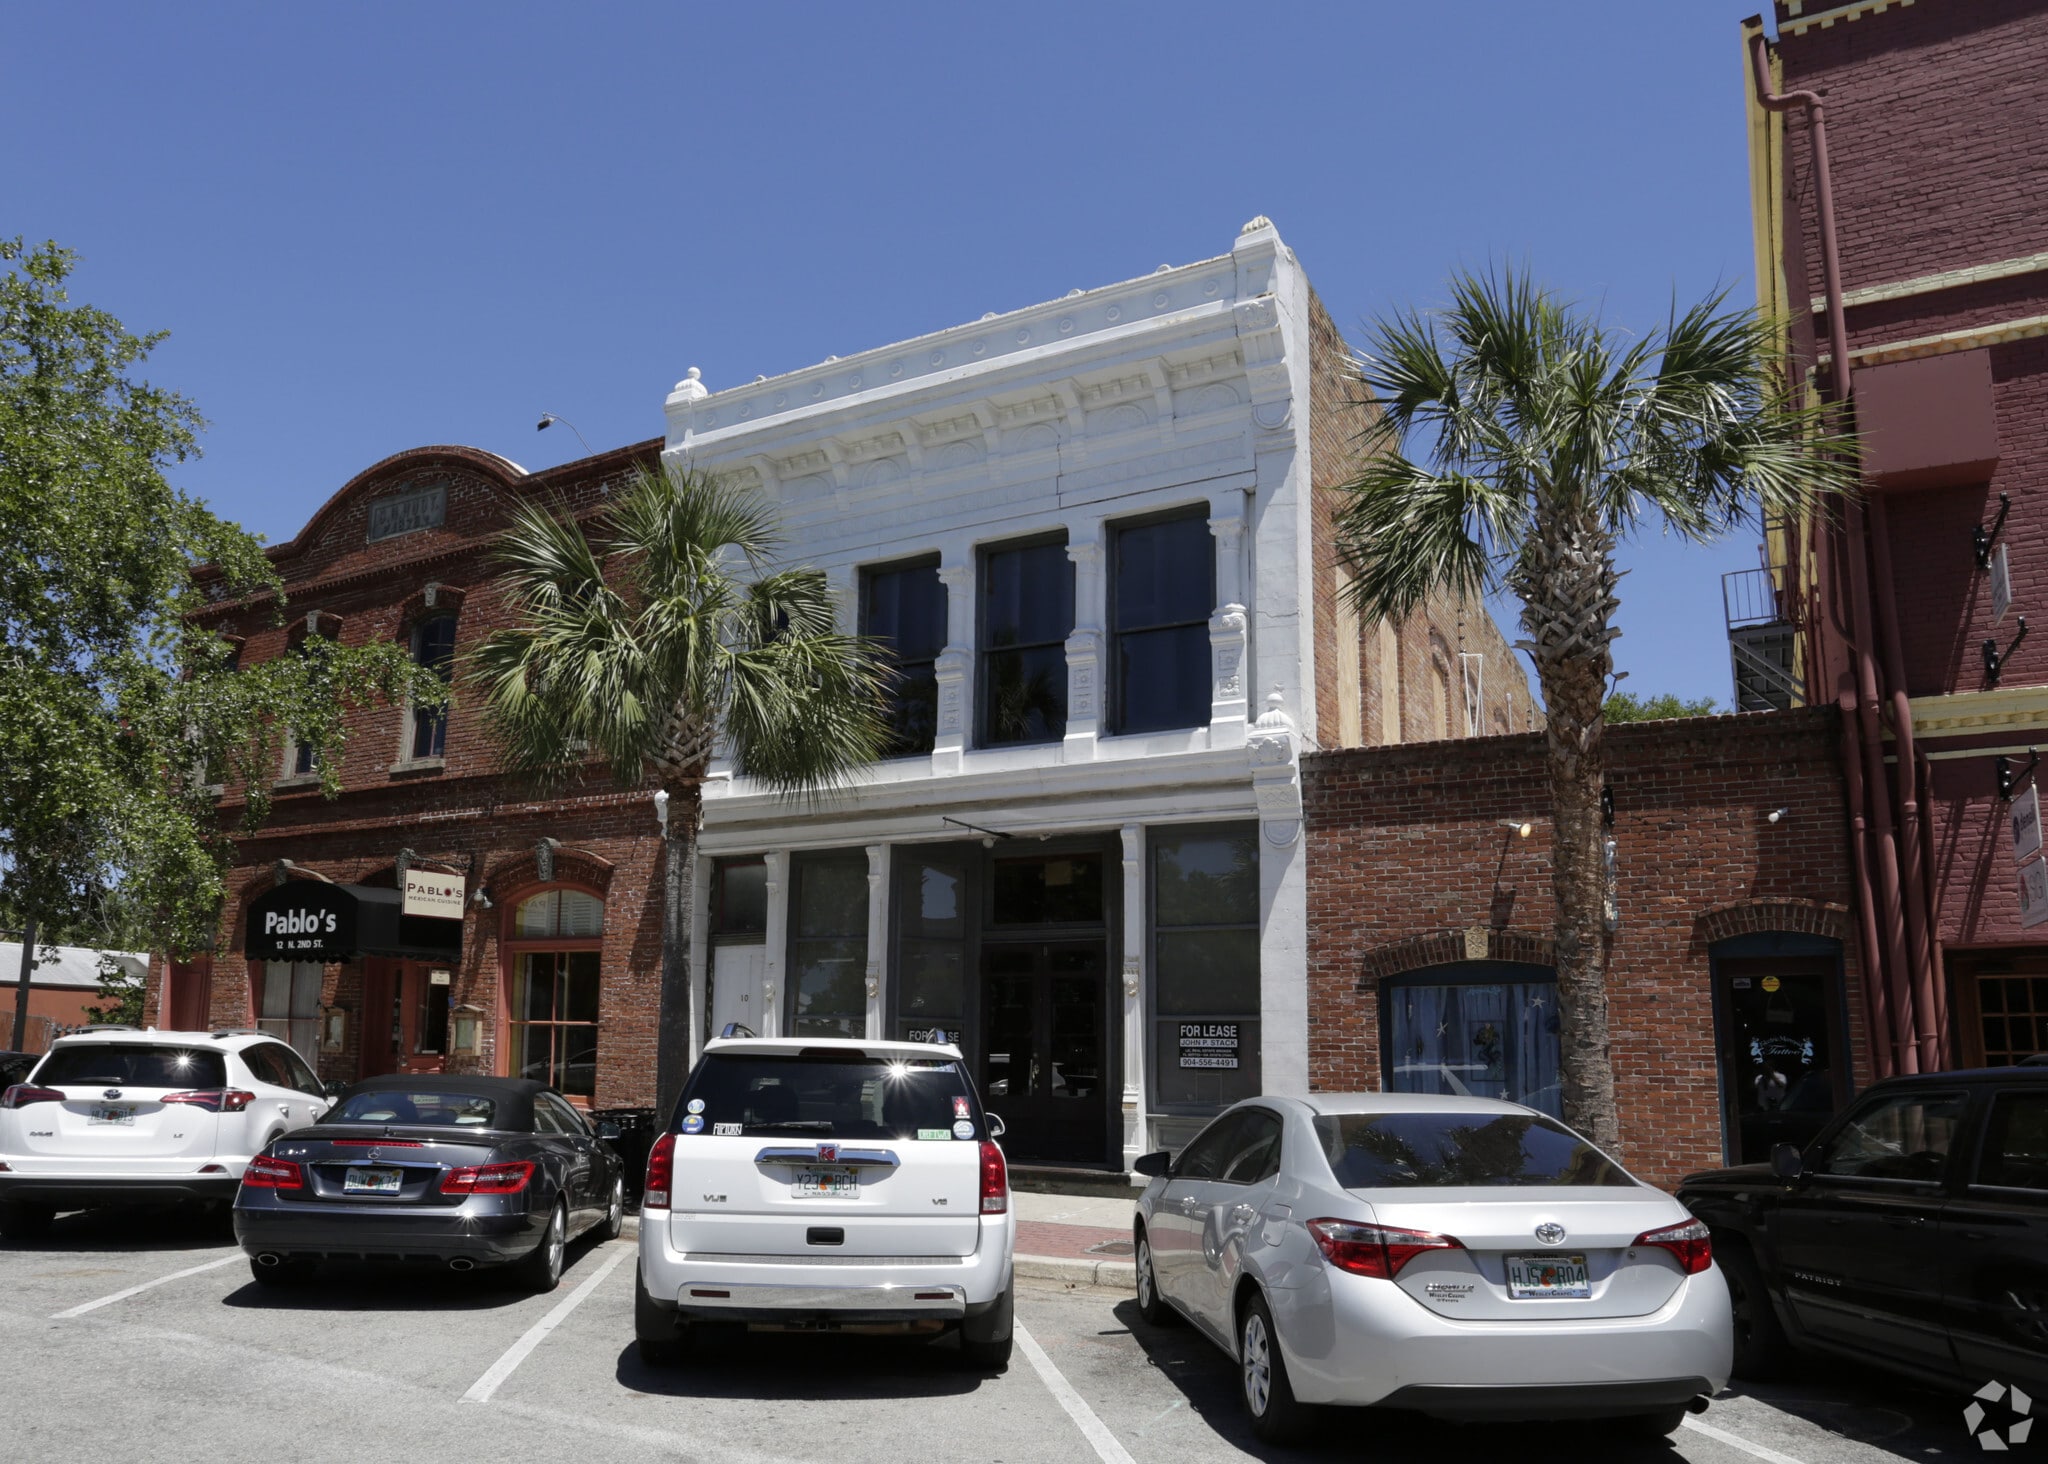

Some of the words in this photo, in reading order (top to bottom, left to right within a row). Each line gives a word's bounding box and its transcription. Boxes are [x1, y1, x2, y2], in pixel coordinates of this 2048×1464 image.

[407, 883, 463, 898] PABLO'S
[437, 898, 461, 906] CUISINE
[265, 908, 336, 934] Pablo's
[276, 941, 284, 949] 12
[297, 940, 312, 949] 2ND
[313, 939, 324, 948] ST.
[740, 994, 749, 1002] 10
[1180, 1025, 1201, 1037] FOR
[1203, 1025, 1237, 1037] LEASE
[1210, 1039, 1236, 1047] STACK
[1182, 1058, 1234, 1066] 904-556-4491
[797, 1174, 819, 1190] Y23
[834, 1174, 857, 1191] BCH
[703, 1194, 727, 1203] VUE
[1511, 1266, 1540, 1287] HJS
[1795, 1271, 1841, 1287] PATRIOT
